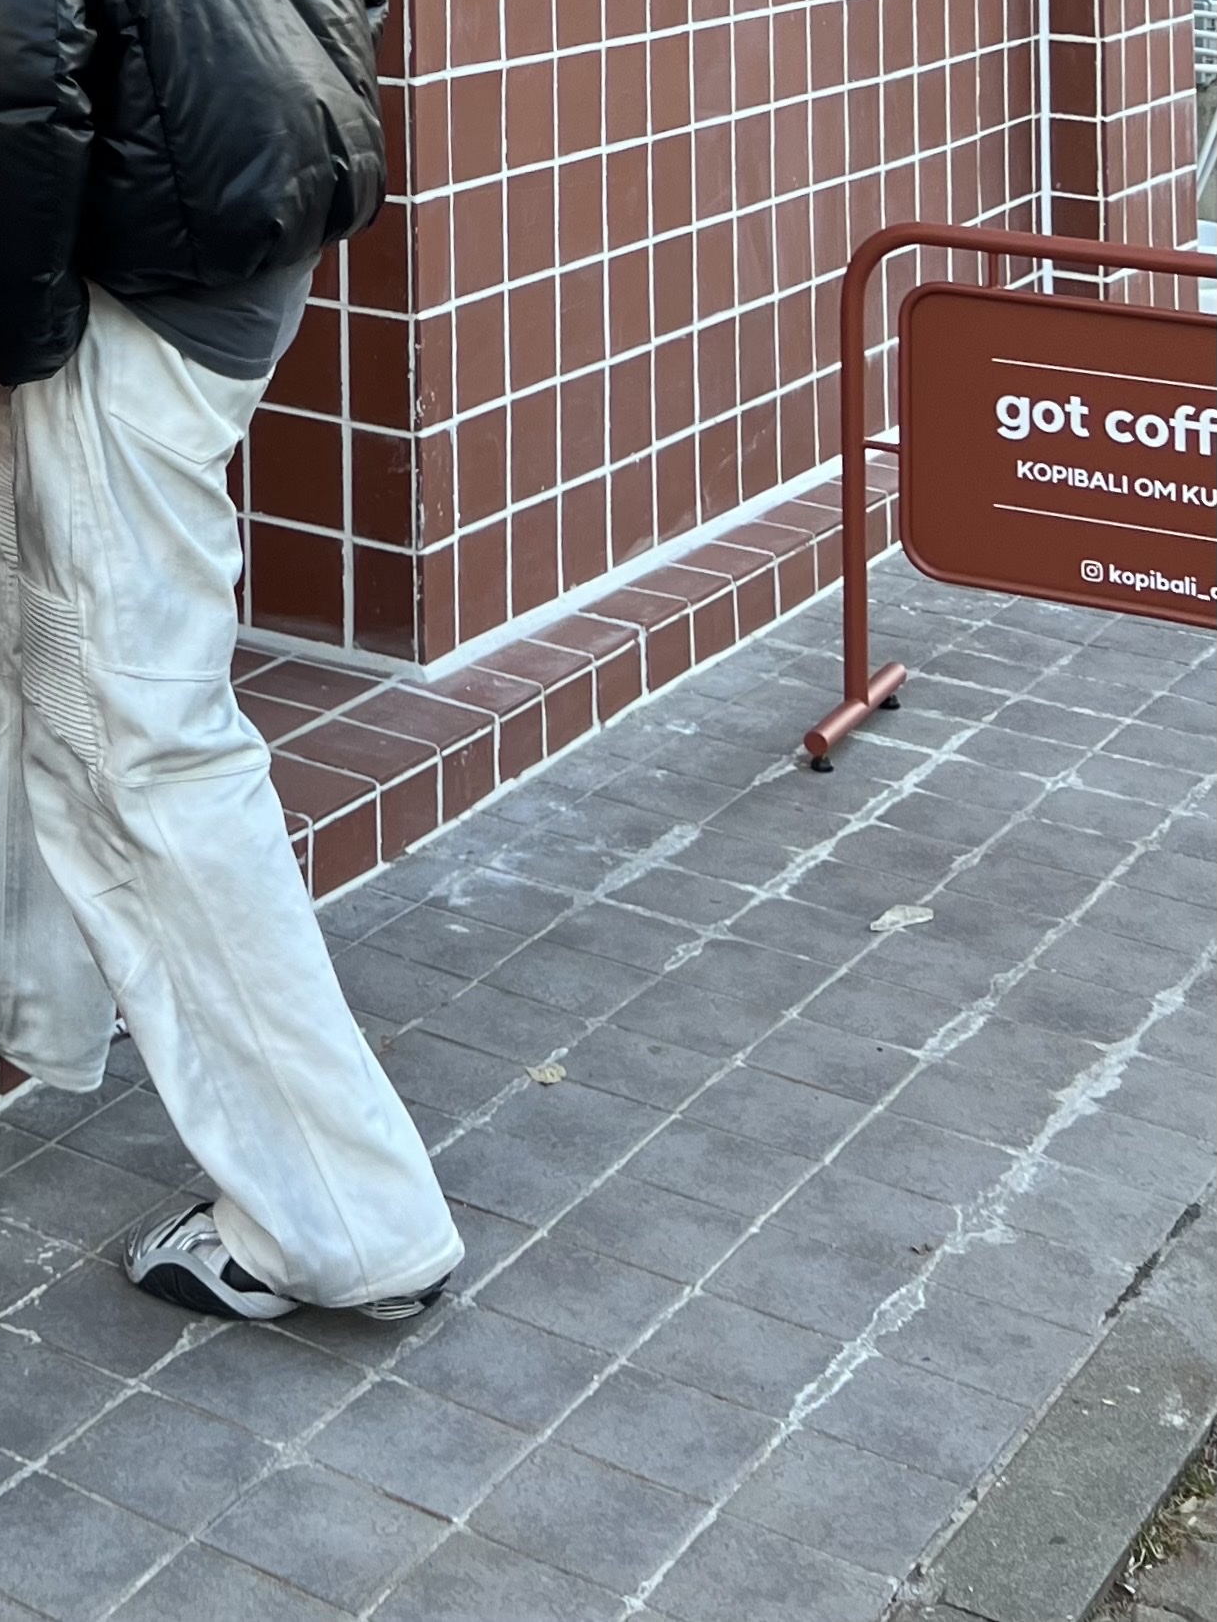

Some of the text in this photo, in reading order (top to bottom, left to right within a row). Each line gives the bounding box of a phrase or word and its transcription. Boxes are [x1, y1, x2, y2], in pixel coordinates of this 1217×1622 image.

[995, 395, 1217, 456] got coff
[1016, 459, 1217, 508] KOPIBALI OM KU
